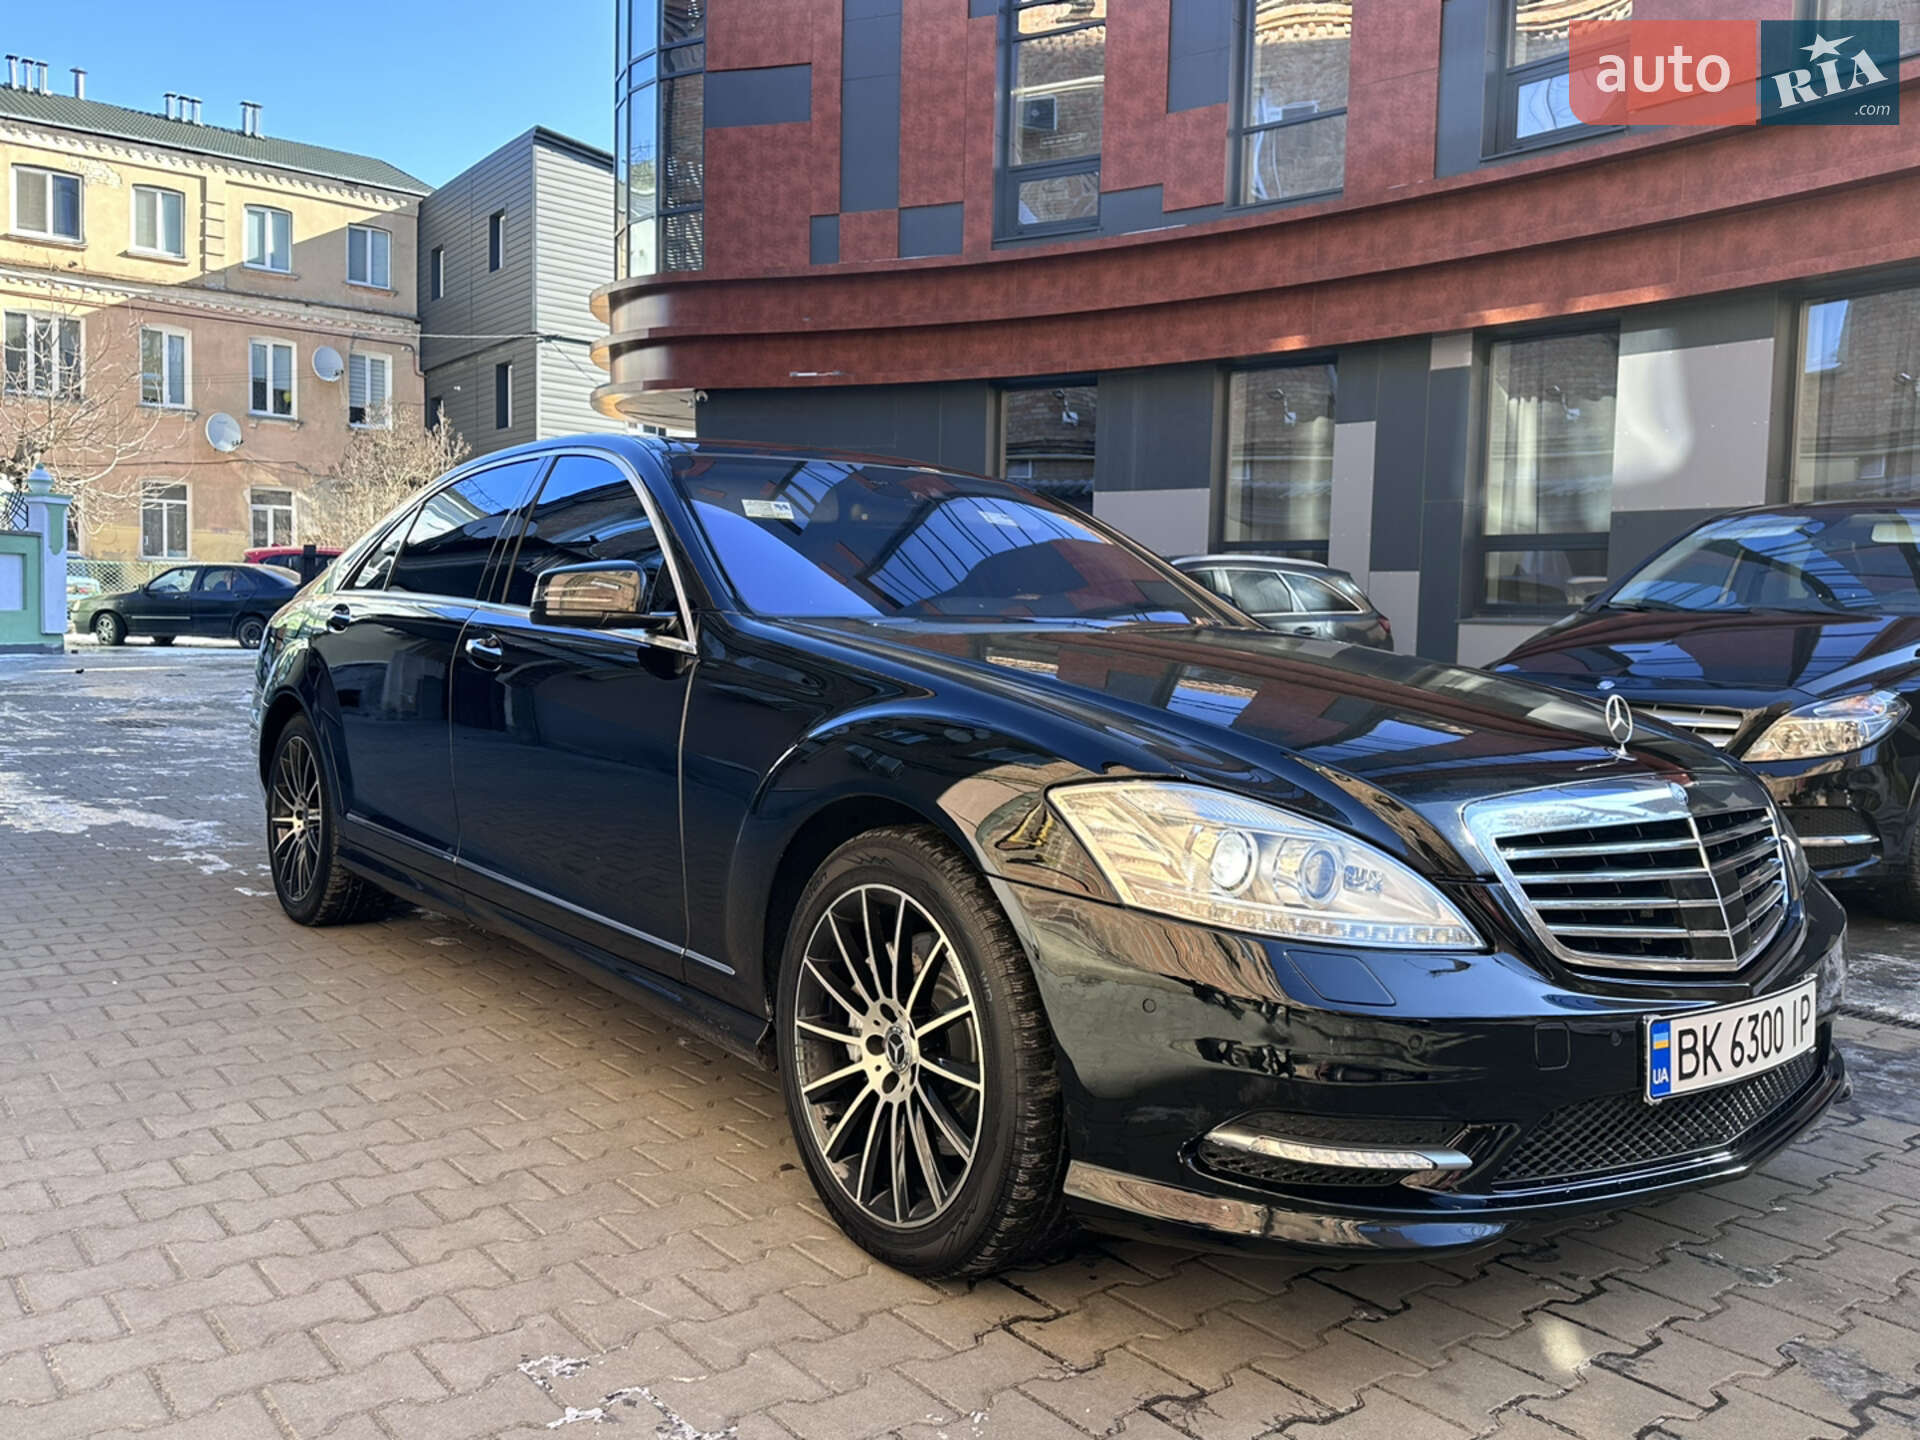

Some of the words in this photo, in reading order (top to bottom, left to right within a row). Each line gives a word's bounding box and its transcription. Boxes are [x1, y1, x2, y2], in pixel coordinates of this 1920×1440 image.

[1678, 1021, 1723, 1082] BK
[1730, 1005, 1784, 1069] 6300
[1792, 994, 1811, 1048] IP
[1652, 1067, 1669, 1085] UA
